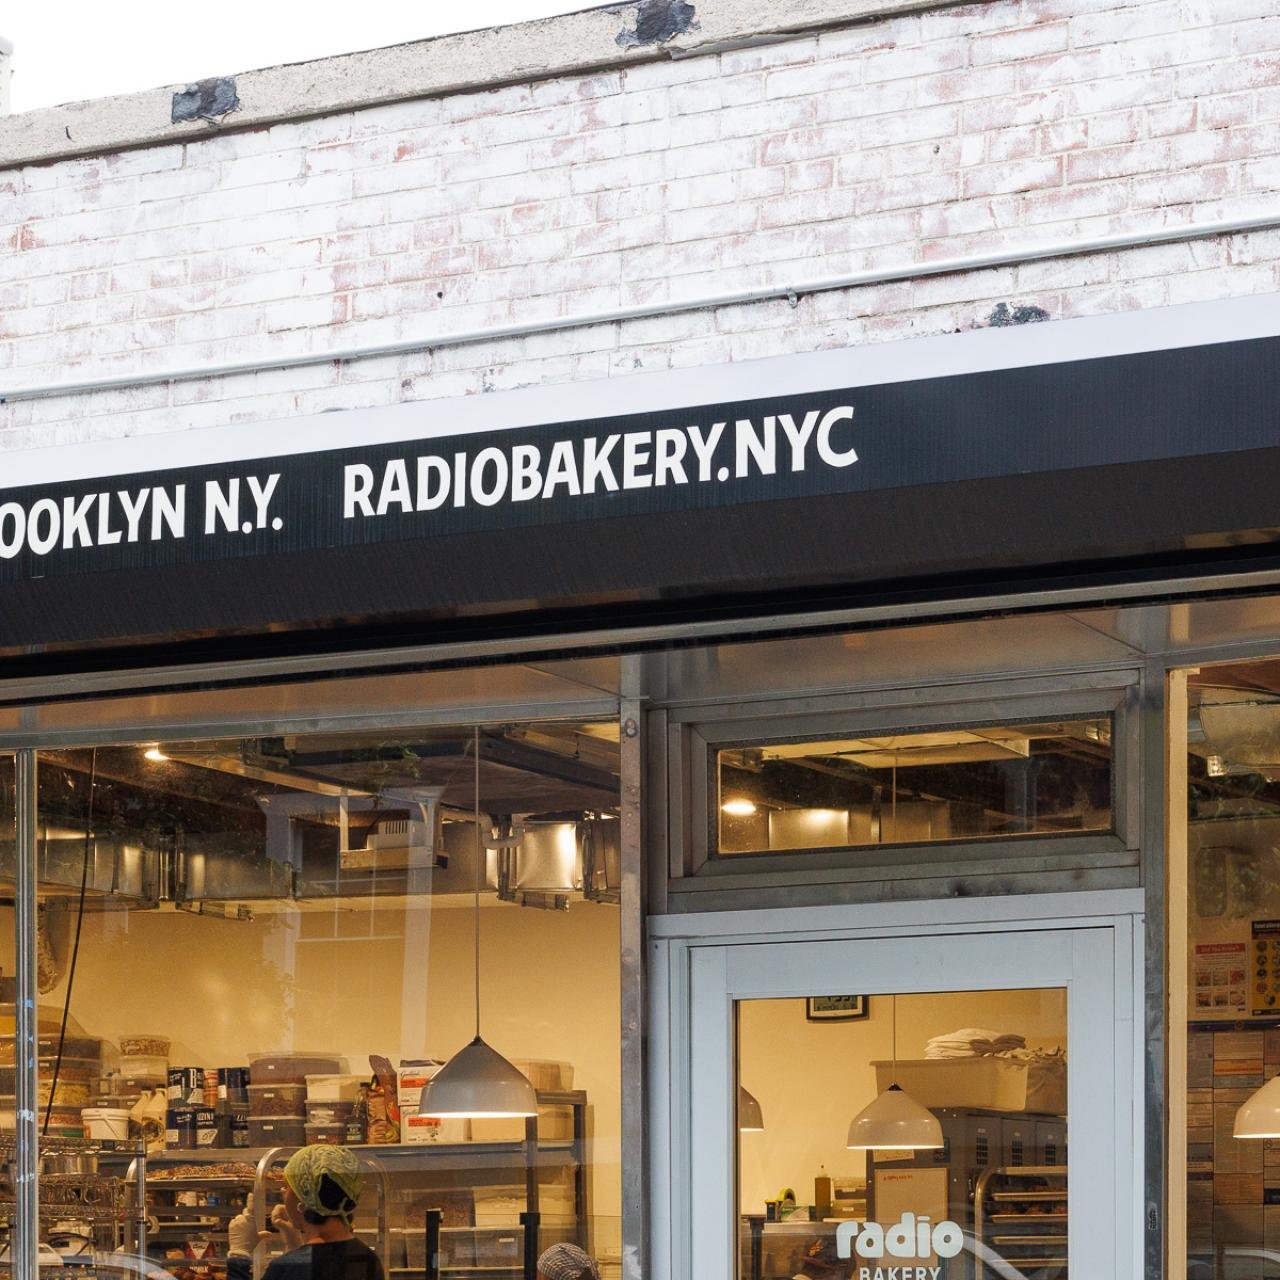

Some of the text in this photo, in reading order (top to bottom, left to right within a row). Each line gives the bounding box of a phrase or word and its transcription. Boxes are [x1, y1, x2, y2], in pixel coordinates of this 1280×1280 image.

[204, 473, 285, 535] N.Y.
[342, 404, 861, 519] RADIOBAKERY.NYC
[836, 1211, 965, 1260] radio
